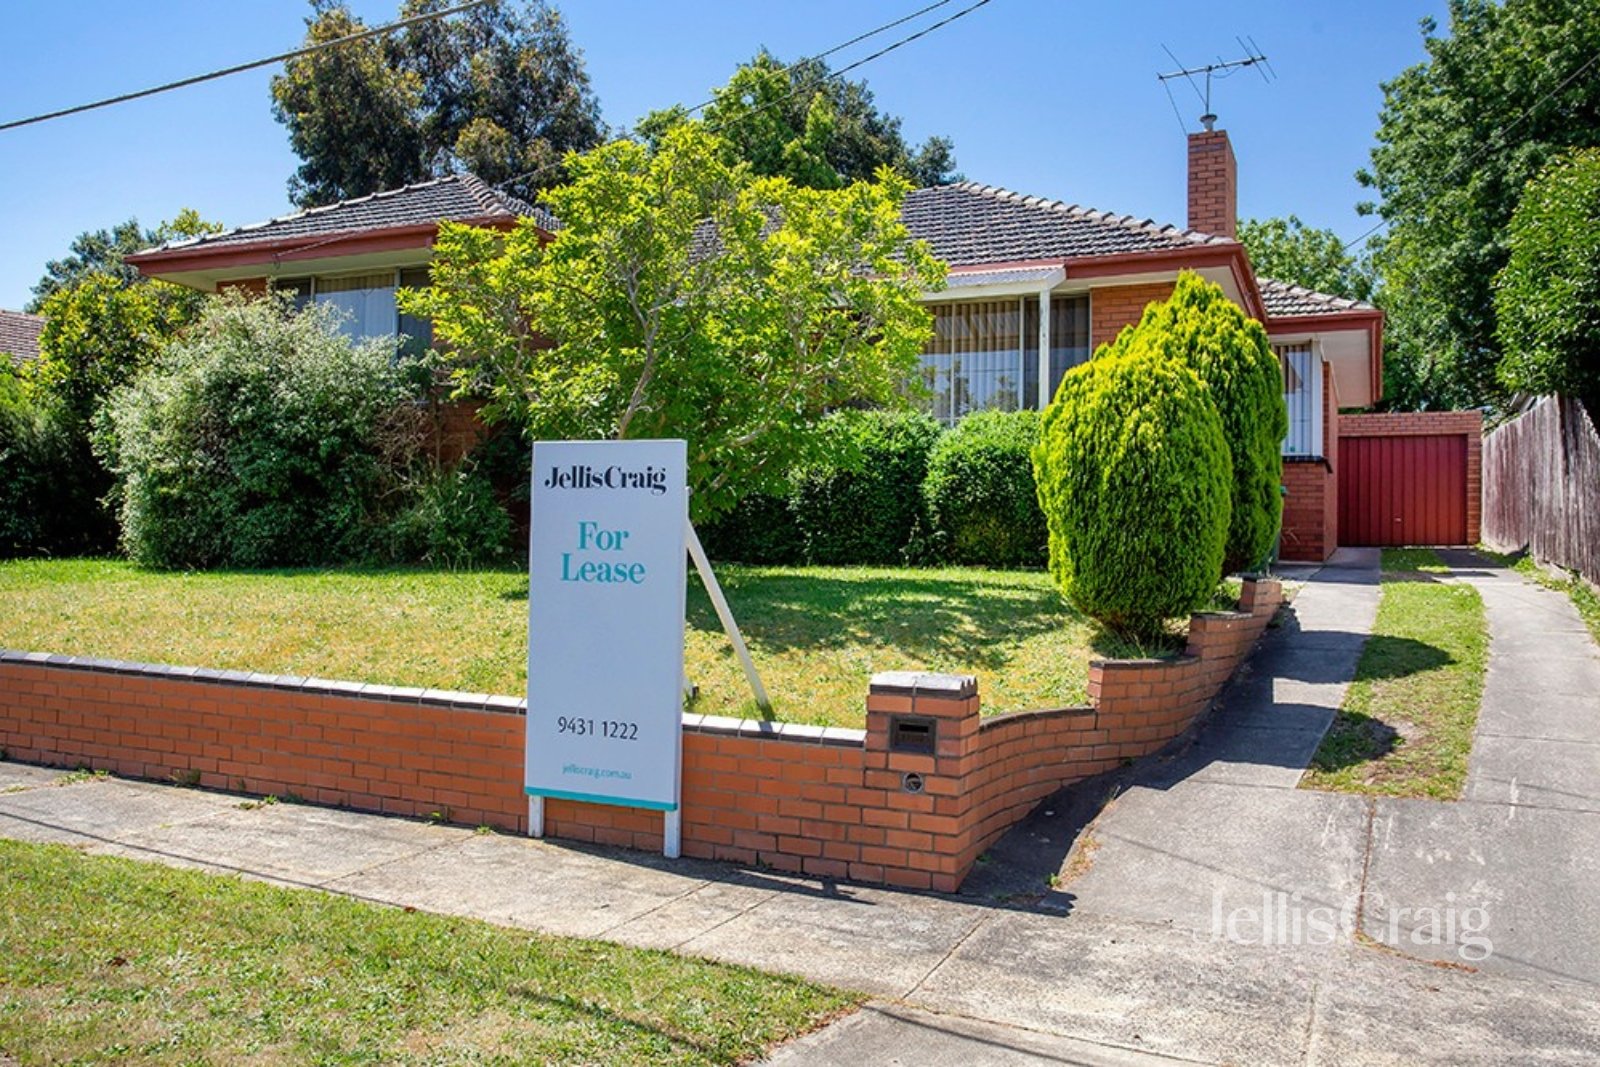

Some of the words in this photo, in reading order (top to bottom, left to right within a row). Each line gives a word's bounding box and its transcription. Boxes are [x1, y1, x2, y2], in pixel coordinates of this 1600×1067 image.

[544, 465, 668, 496] JellisCraig
[577, 521, 630, 551] For
[560, 552, 646, 584] Lease
[557, 716, 594, 736] 9431
[601, 721, 639, 741] 1222
[562, 764, 632, 779] jelliscraig.com.au
